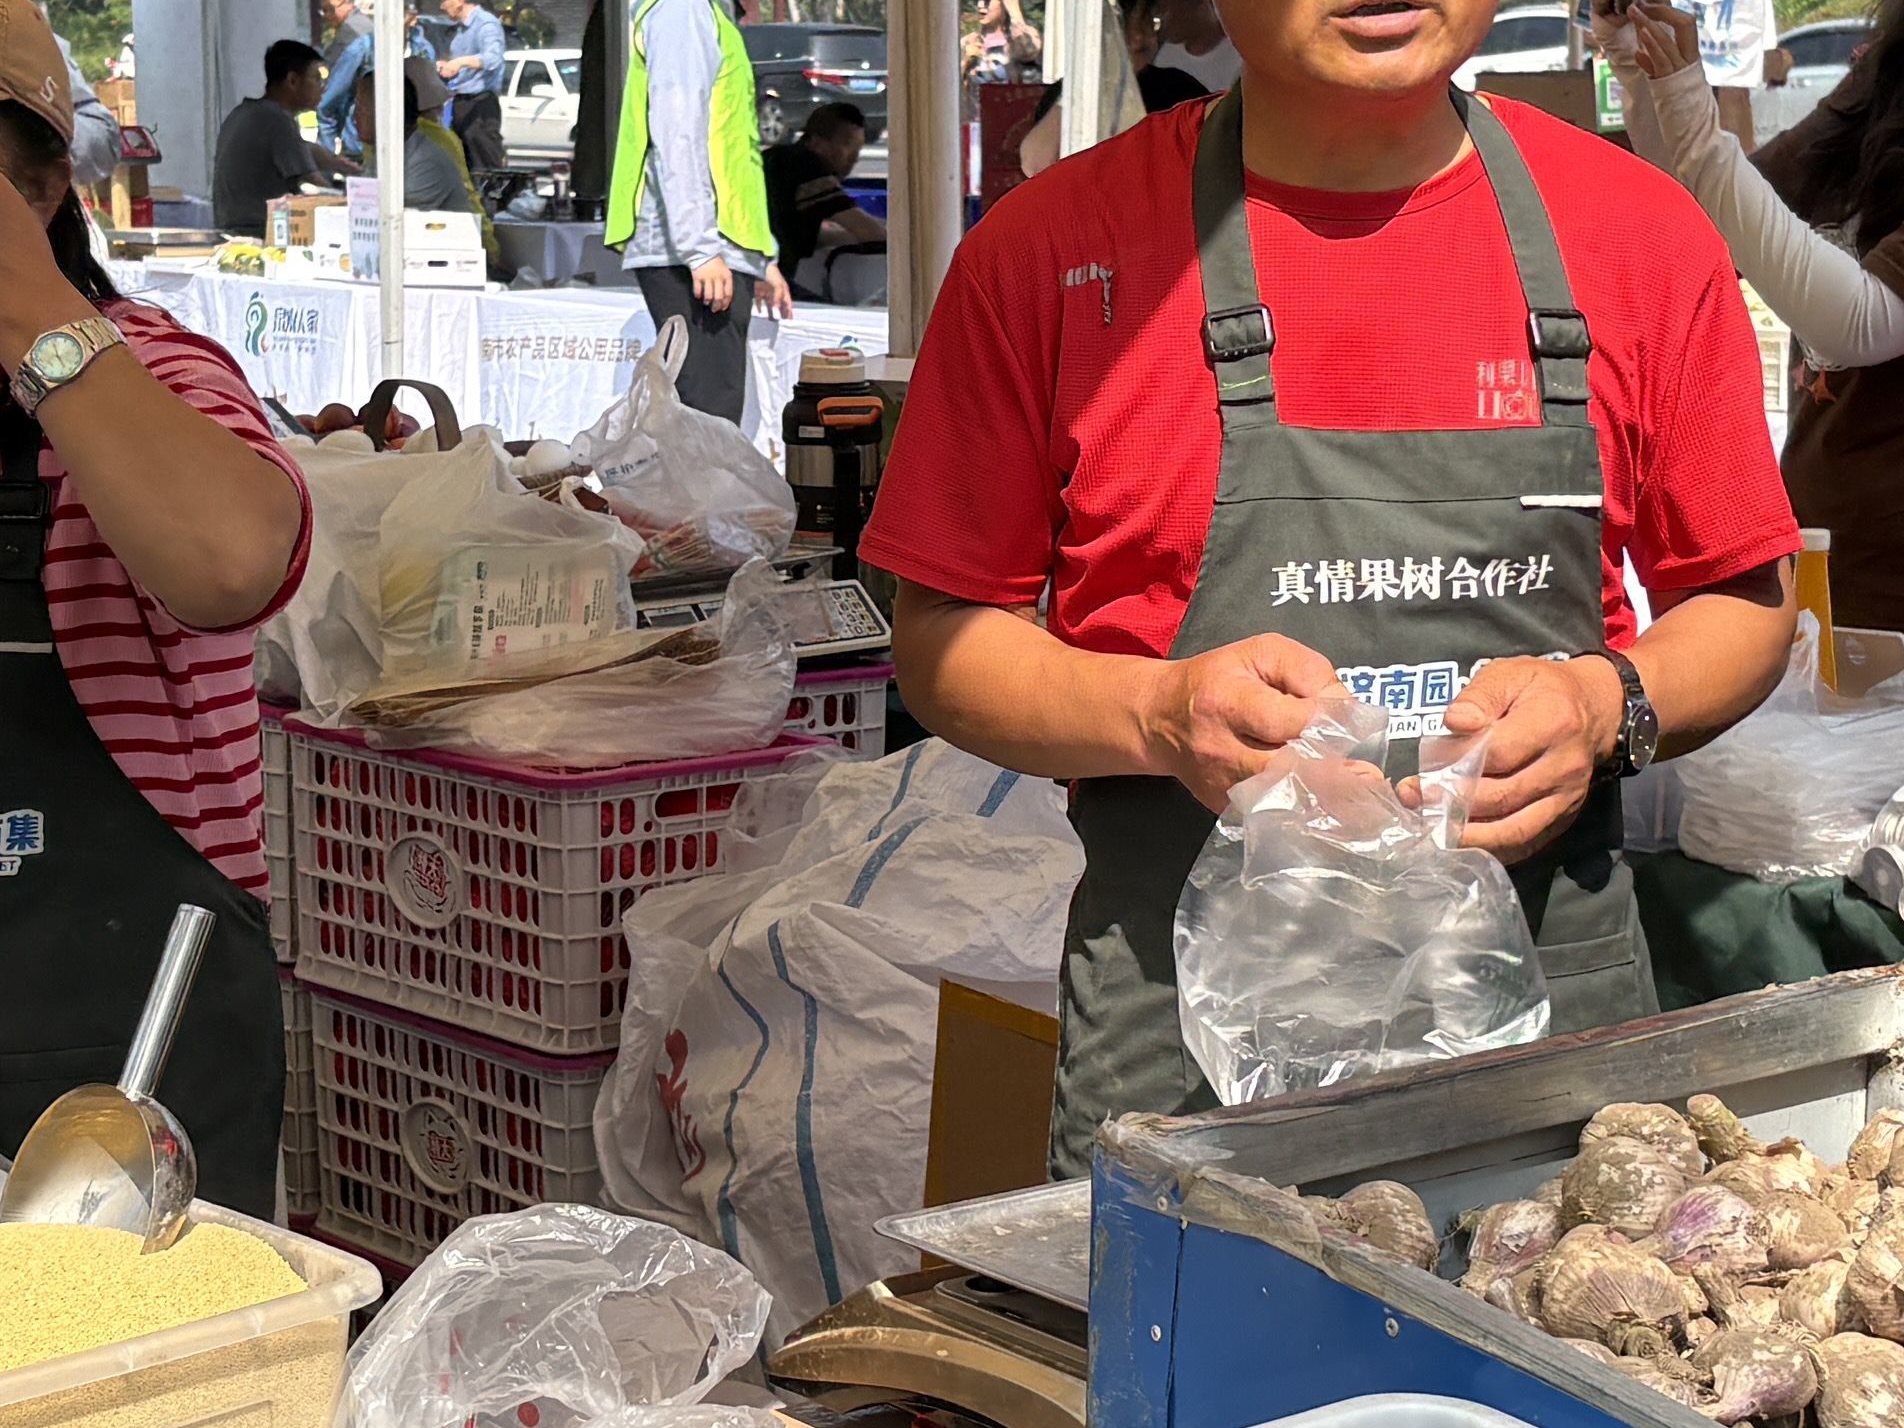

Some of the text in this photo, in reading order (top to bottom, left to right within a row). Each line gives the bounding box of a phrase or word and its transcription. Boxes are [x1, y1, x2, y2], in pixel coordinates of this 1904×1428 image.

[1270, 554, 1554, 607] 真情果树合作社
